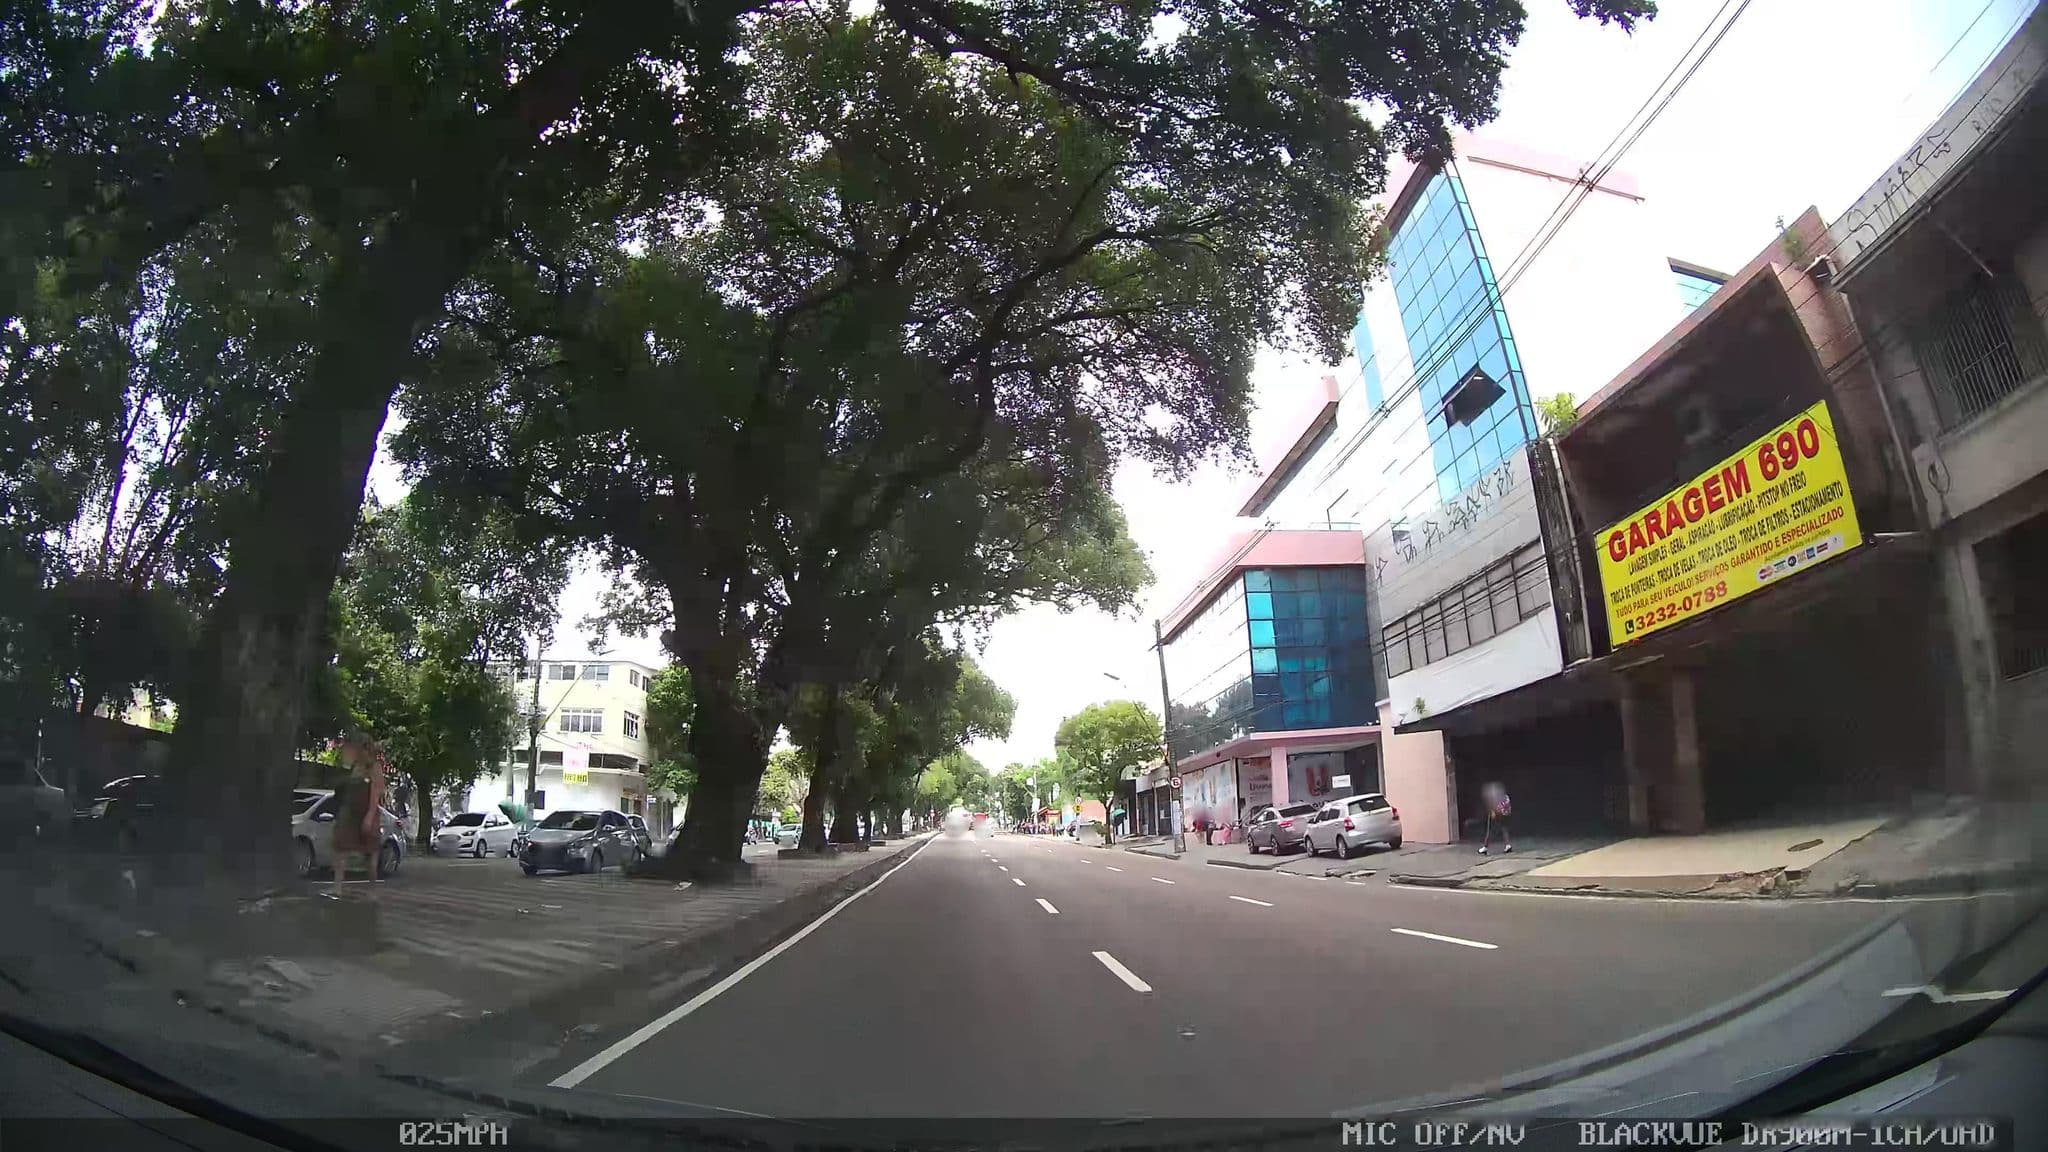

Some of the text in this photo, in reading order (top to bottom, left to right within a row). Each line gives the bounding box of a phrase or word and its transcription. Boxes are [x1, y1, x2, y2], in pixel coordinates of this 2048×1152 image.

[1607, 458, 1751, 563] GARAGEM
[1758, 418, 1820, 481] 690
[1610, 587, 1624, 606] TROCA
[1624, 584, 1630, 599] DE
[1630, 573, 1655, 596] PONTEIRAS
[1657, 564, 1673, 584] TROCA
[1672, 560, 1680, 577] DE
[1679, 553, 1695, 574] VELAS
[1697, 544, 1715, 565] TROCA
[1714, 540, 1723, 557] DE
[1738, 523, 1758, 545] TROCA
[1757, 519, 1766, 536] DE
[1764, 507, 1789, 532] FILTROS
[1790, 480, 1843, 519] ESTACIONAMENTO
[1628, 553, 1648, 575] LAVAGEM
[1647, 543, 1667, 565] SIMPLES
[1669, 534, 1685, 555] GERAL
[1756, 484, 1780, 510] PITSTOP
[1779, 479, 1789, 498] NO
[1787, 469, 1807, 493] FREIO
[1632, 595, 1649, 611] PARA
[1649, 589, 1662, 604] SEU
[1730, 538, 1774, 568] GARANTIDO
[1774, 535, 1780, 547] E
[1780, 504, 1844, 544] ESPECIALIZADO
[1635, 578, 1728, 632] 3232-0788
